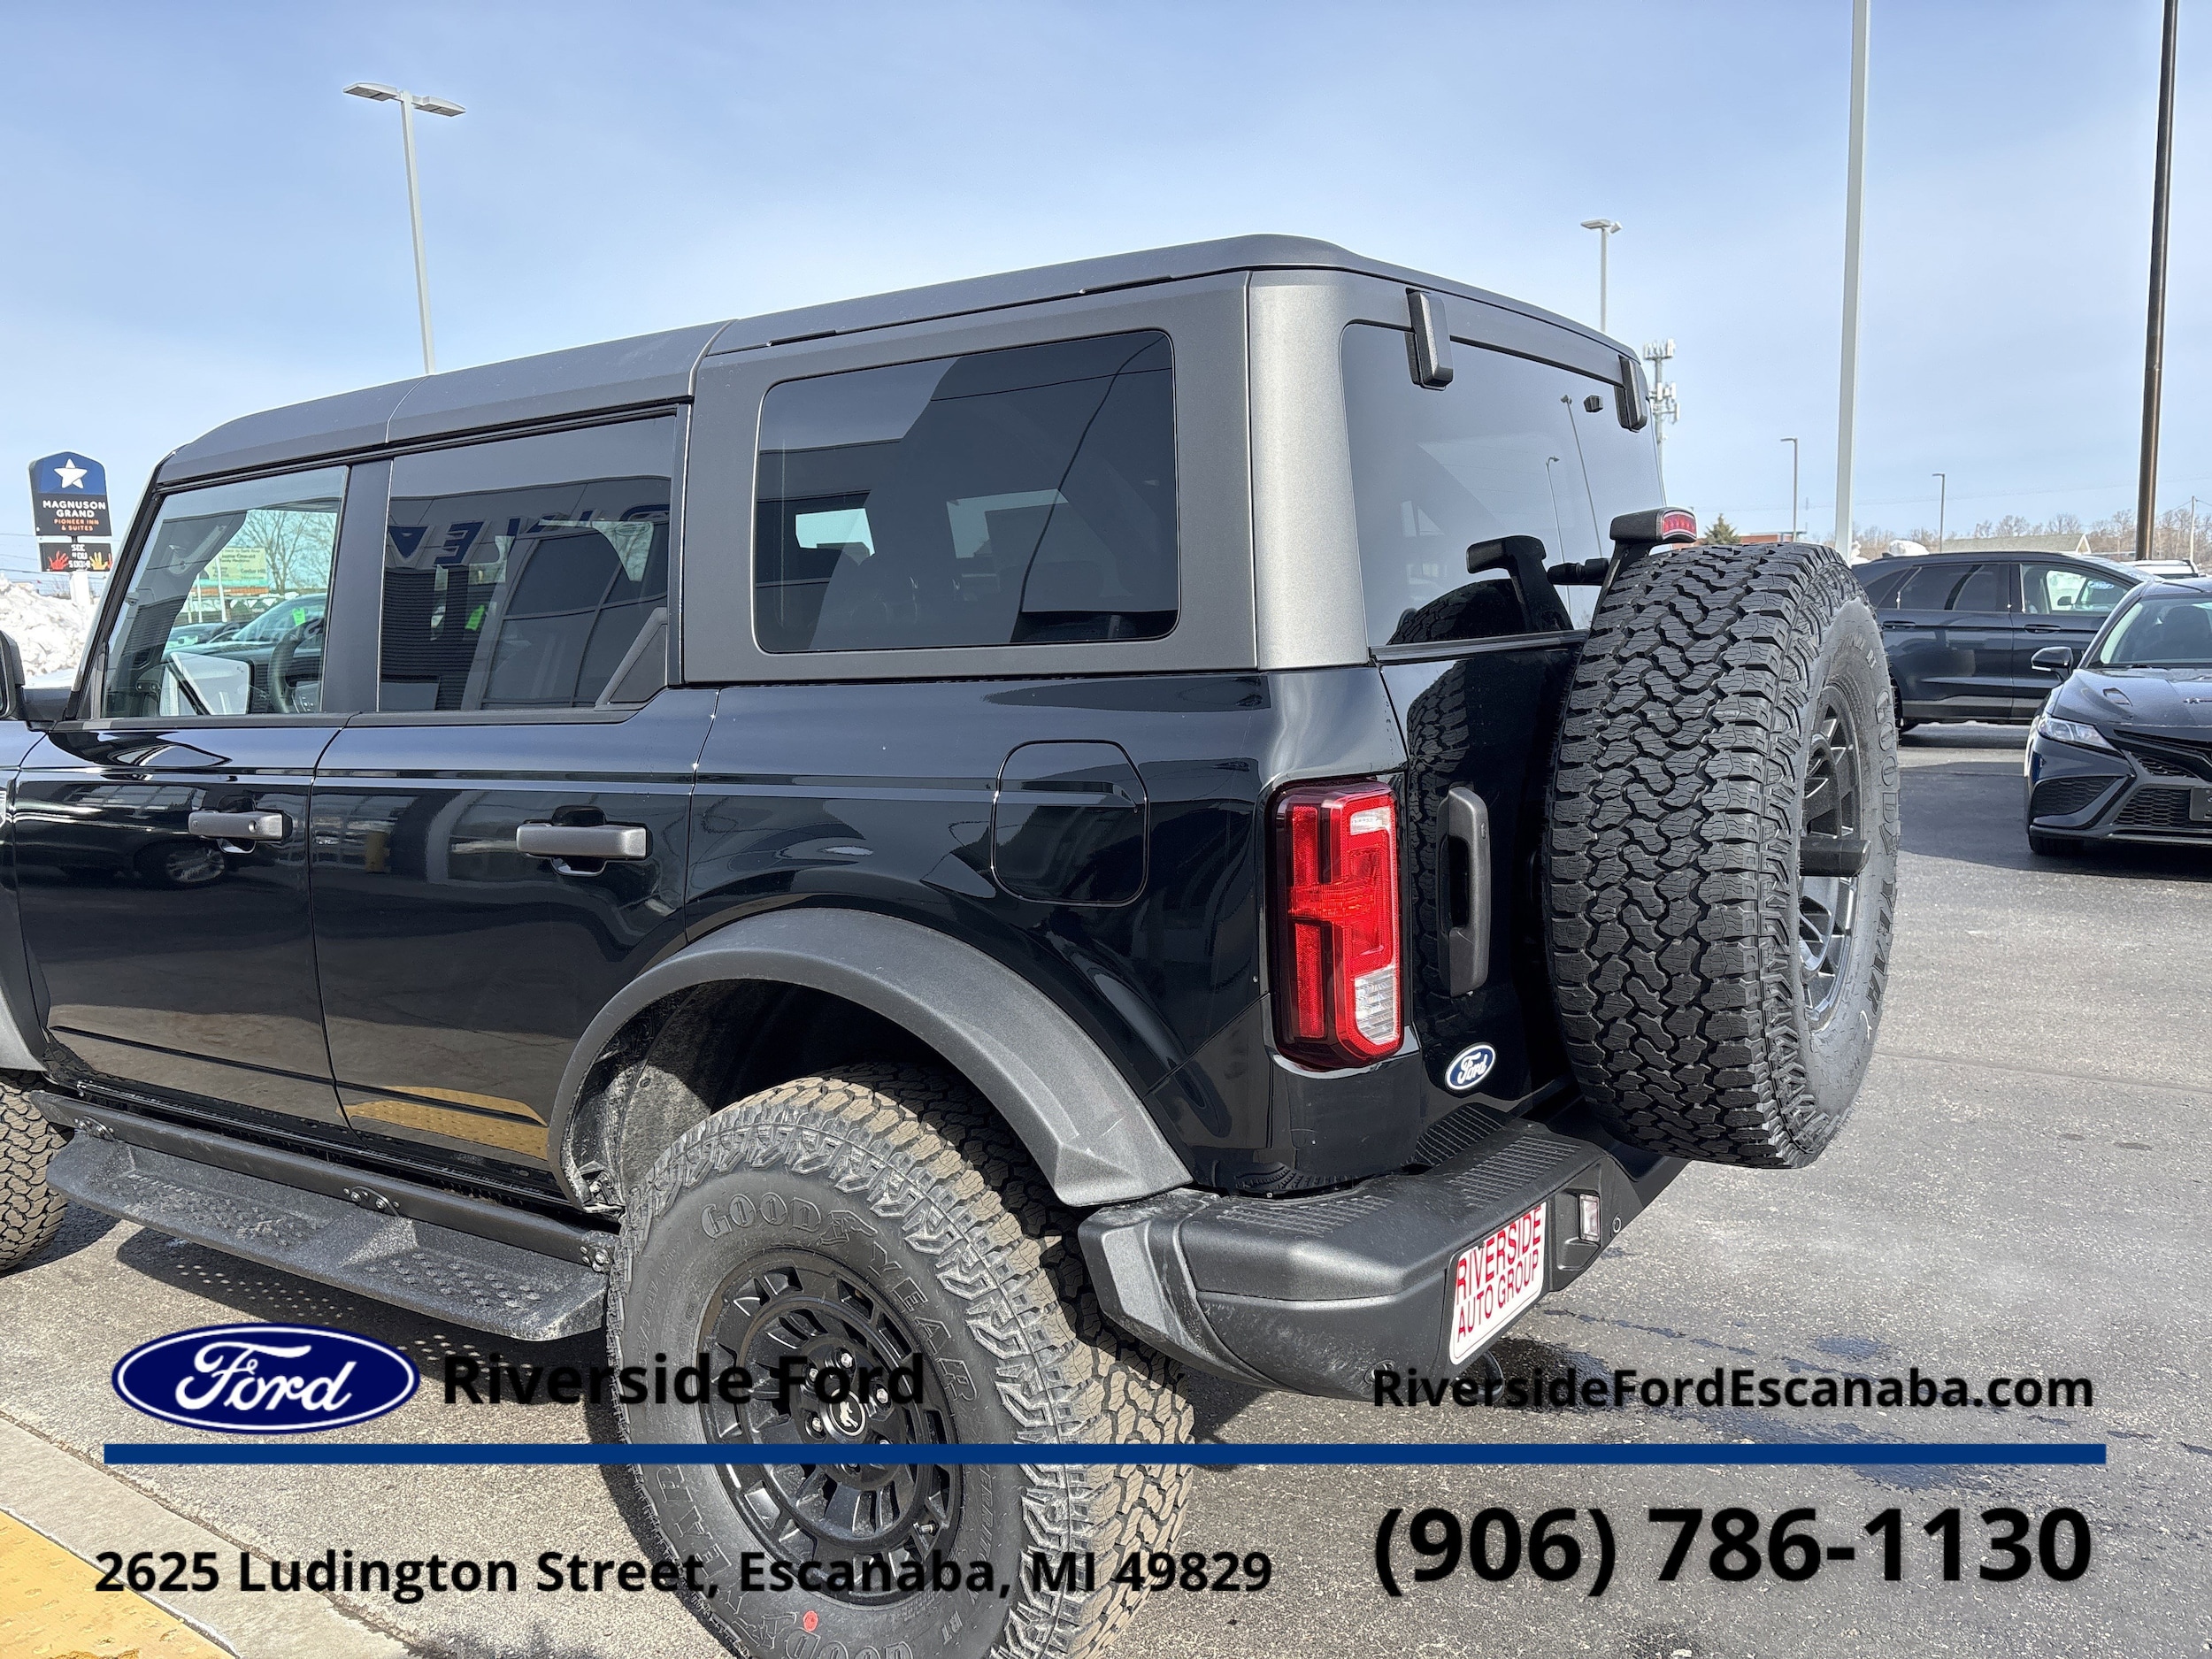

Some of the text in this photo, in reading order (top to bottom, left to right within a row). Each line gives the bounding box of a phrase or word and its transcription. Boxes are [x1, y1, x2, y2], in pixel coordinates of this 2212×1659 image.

[42, 500, 106, 510] MAGNUSON
[71, 543, 86, 552] SEE
[1456, 1051, 1488, 1085] Ford
[1455, 1204, 1541, 1306] RIVERSIDE
[1457, 1248, 1540, 1343] AUTO GROUP
